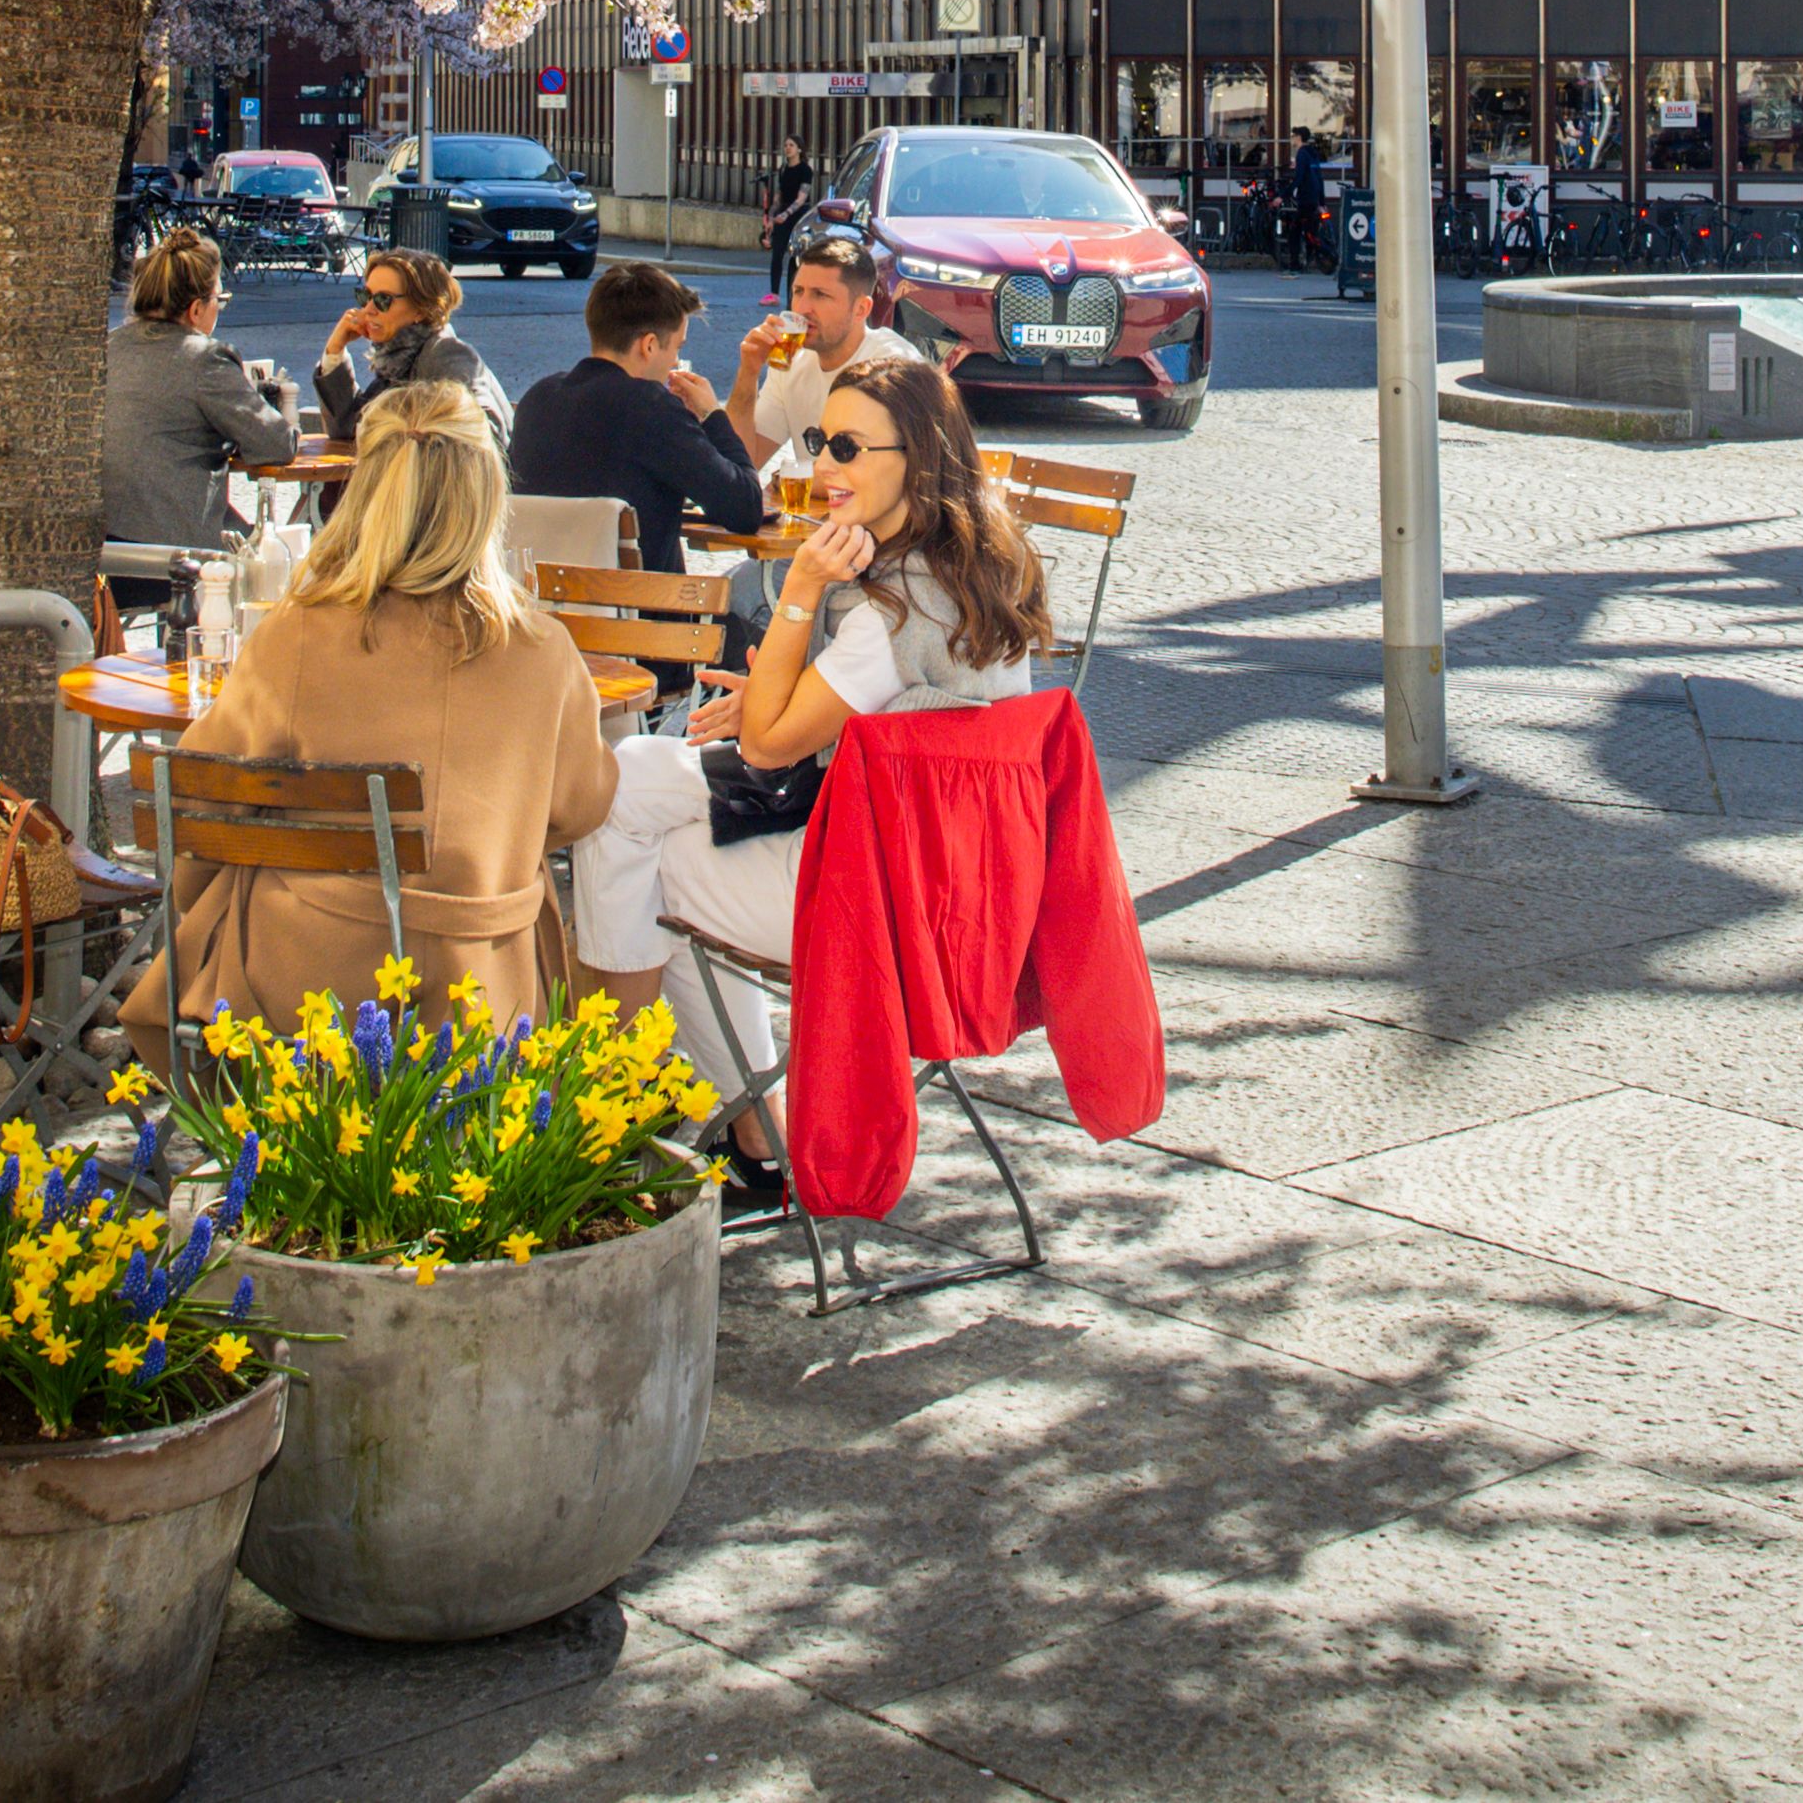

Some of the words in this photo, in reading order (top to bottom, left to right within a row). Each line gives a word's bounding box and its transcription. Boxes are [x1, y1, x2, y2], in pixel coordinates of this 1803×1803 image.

[831, 76, 866, 86] BIKE
[245, 100, 255, 113] P
[1667, 105, 1691, 113] BIKE
[1027, 328, 1047, 343] EH
[1055, 329, 1101, 344] 91240
